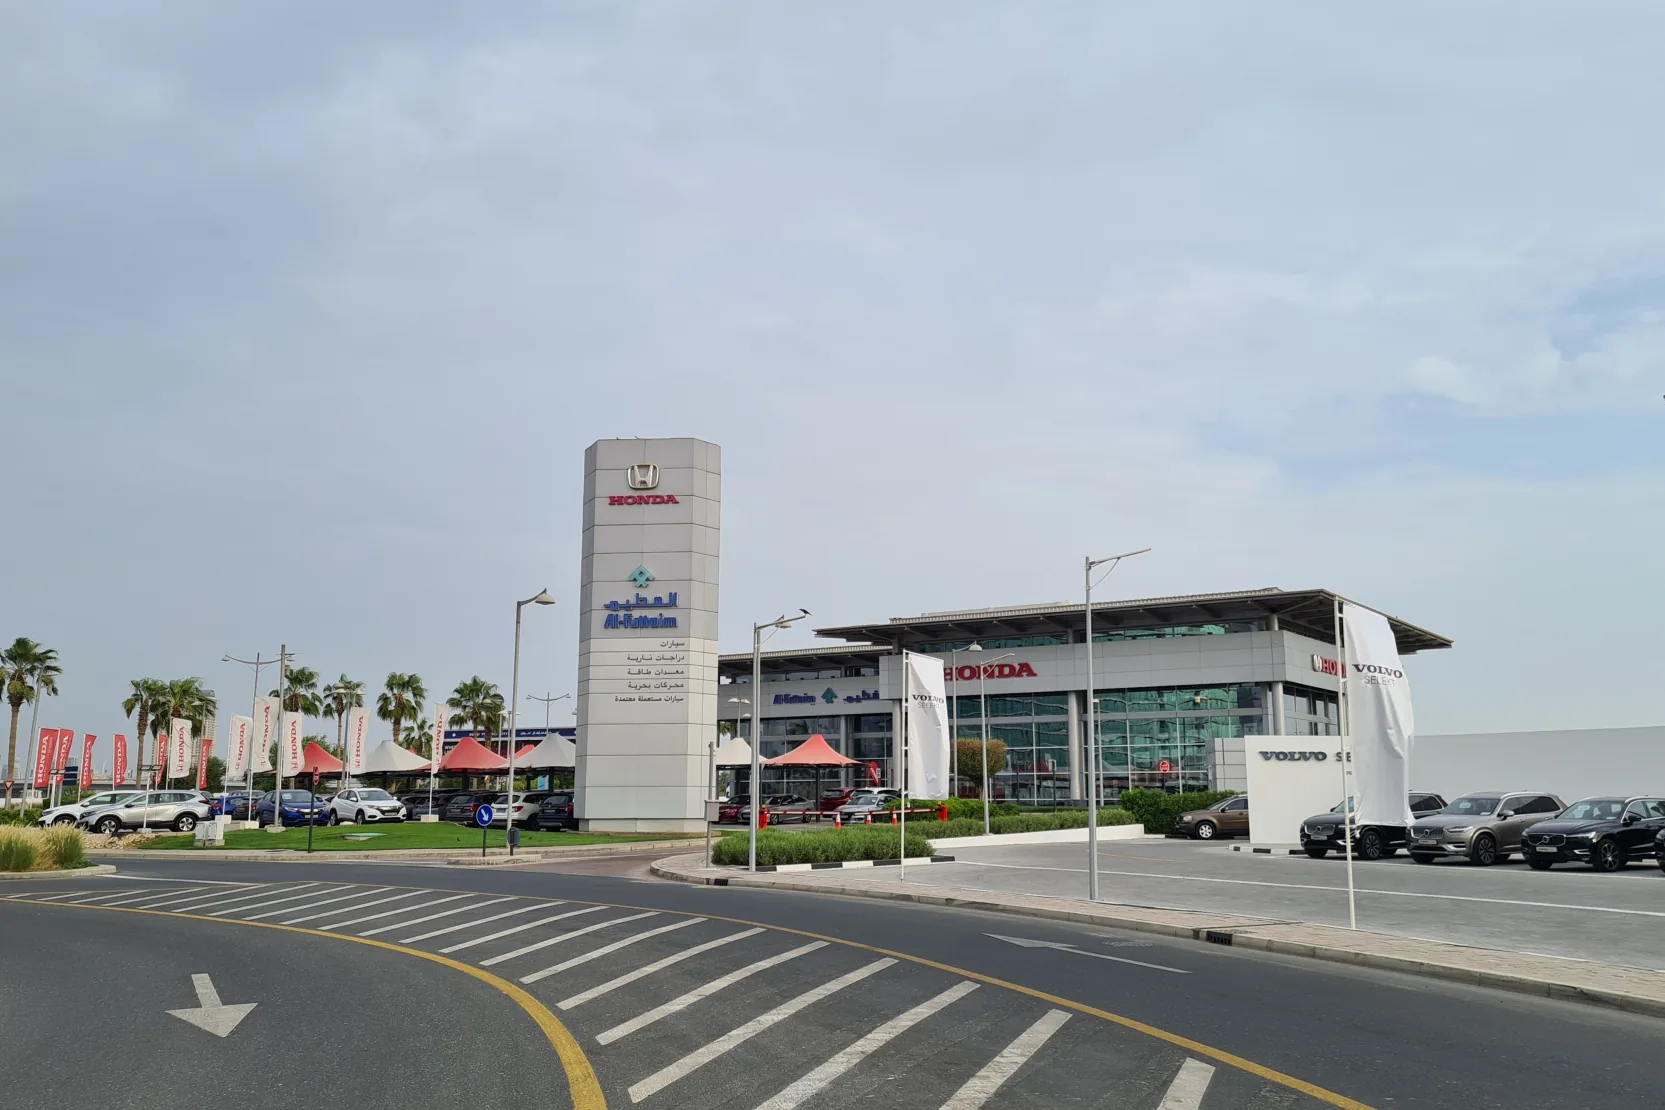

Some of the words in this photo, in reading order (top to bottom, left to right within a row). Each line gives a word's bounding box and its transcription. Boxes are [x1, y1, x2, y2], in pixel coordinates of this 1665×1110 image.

[609, 495, 679, 506] HONDA
[604, 613, 678, 628] Al-Futtaim
[660, 640, 685, 648] سيارات
[627, 653, 653, 663] نارية
[655, 654, 685, 662] دراجات
[944, 663, 1037, 681] HONDA
[1352, 664, 1403, 679] VOLVO
[628, 681, 651, 690] بحرية
[654, 682, 684, 690] محركات
[664, 695, 684, 703] سيارات
[912, 694, 945, 704] VOLVO
[238, 723, 246, 761] HONDA
[355, 716, 364, 758] HONDA
[37, 735, 50, 783] HONDA
[1259, 751, 1327, 762] VOLVO
